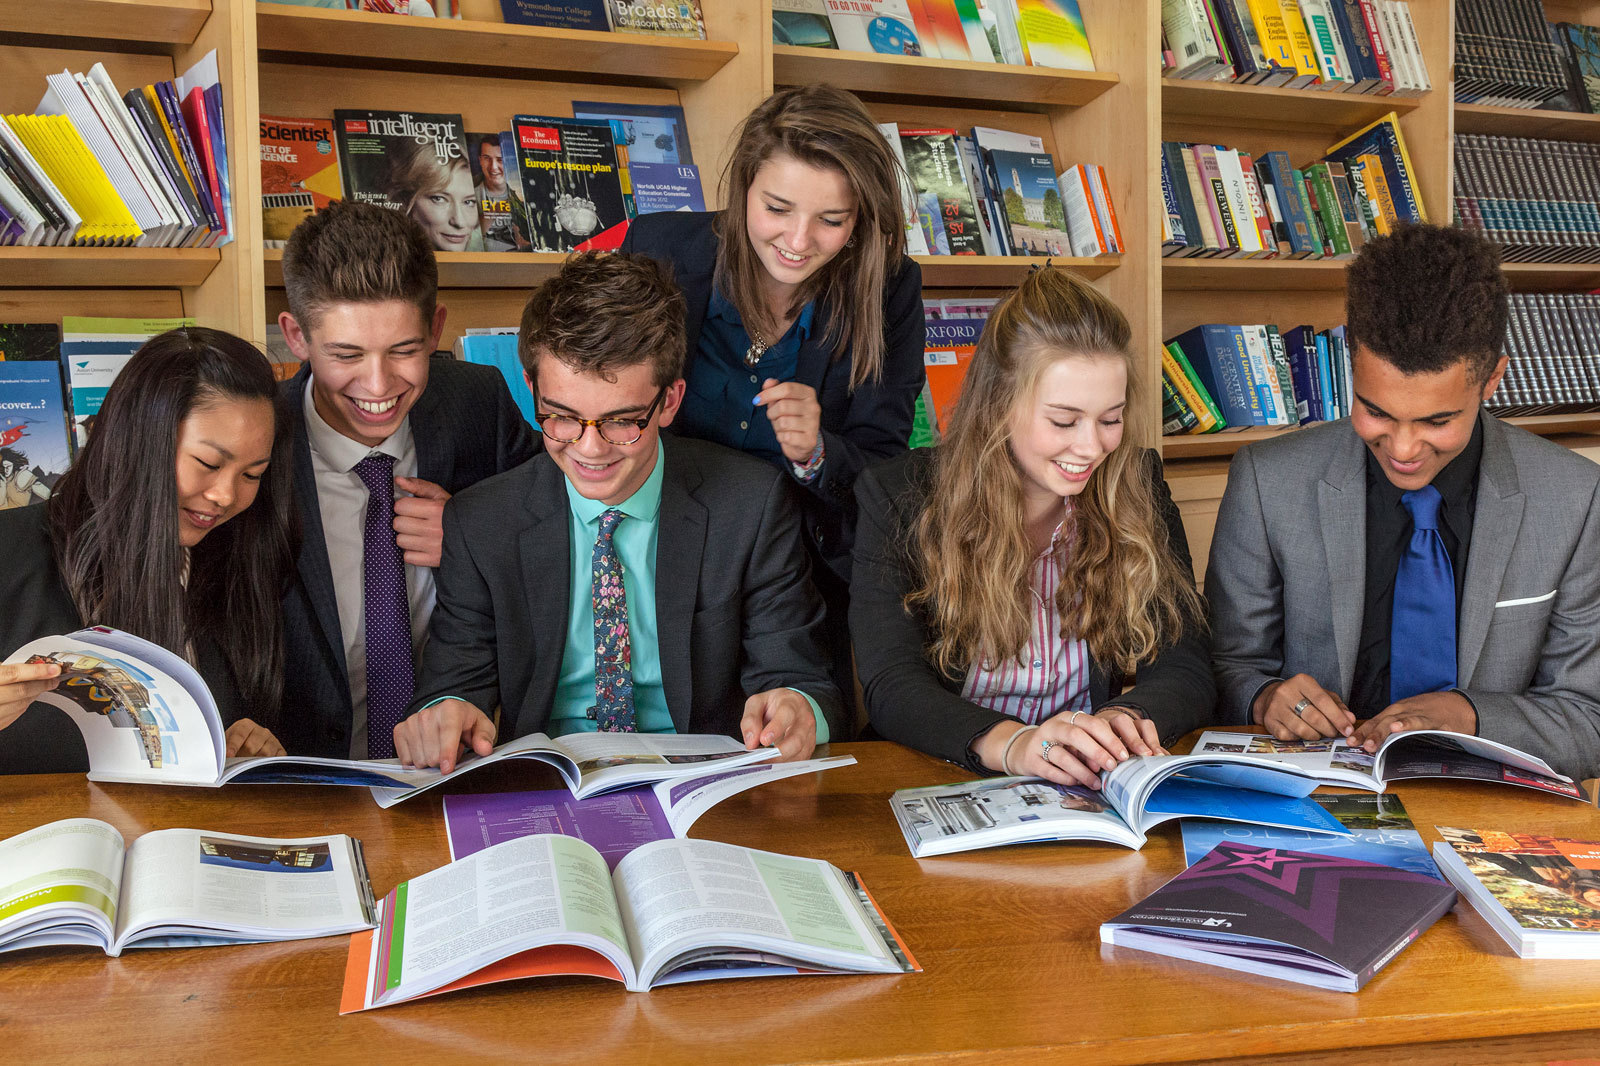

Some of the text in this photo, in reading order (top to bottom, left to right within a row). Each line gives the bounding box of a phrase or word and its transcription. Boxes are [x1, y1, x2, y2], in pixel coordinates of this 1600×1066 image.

[564, 6, 593, 17] College
[615, 0, 676, 19] Broads
[619, 17, 693, 30] Outdoors Festival
[876, 19, 888, 28] BU
[1363, 4, 1377, 33] SPANISH
[1372, 34, 1385, 55] VERBS
[260, 122, 331, 143] Scientist
[368, 112, 457, 144] intelligent
[533, 130, 546, 138] The
[279, 146, 291, 154] OF
[435, 135, 461, 166] life
[522, 136, 559, 146] Economist
[525, 157, 612, 174] Europe's rescue plan
[930, 141, 944, 179] Studies
[938, 141, 953, 187] Business
[945, 204, 959, 216] A2
[1214, 182, 1235, 233] BREWER'S
[949, 222, 964, 234] AS
[1216, 347, 1239, 409] DICTIONARY
[1235, 334, 1258, 409] Good University
[1267, 364, 1280, 394] 2011
[1169, 361, 1203, 413] University Guide
[1227, 361, 1246, 409] CENTURY
[1173, 394, 1187, 414] Guide
[0, 888, 52, 910] Manag
